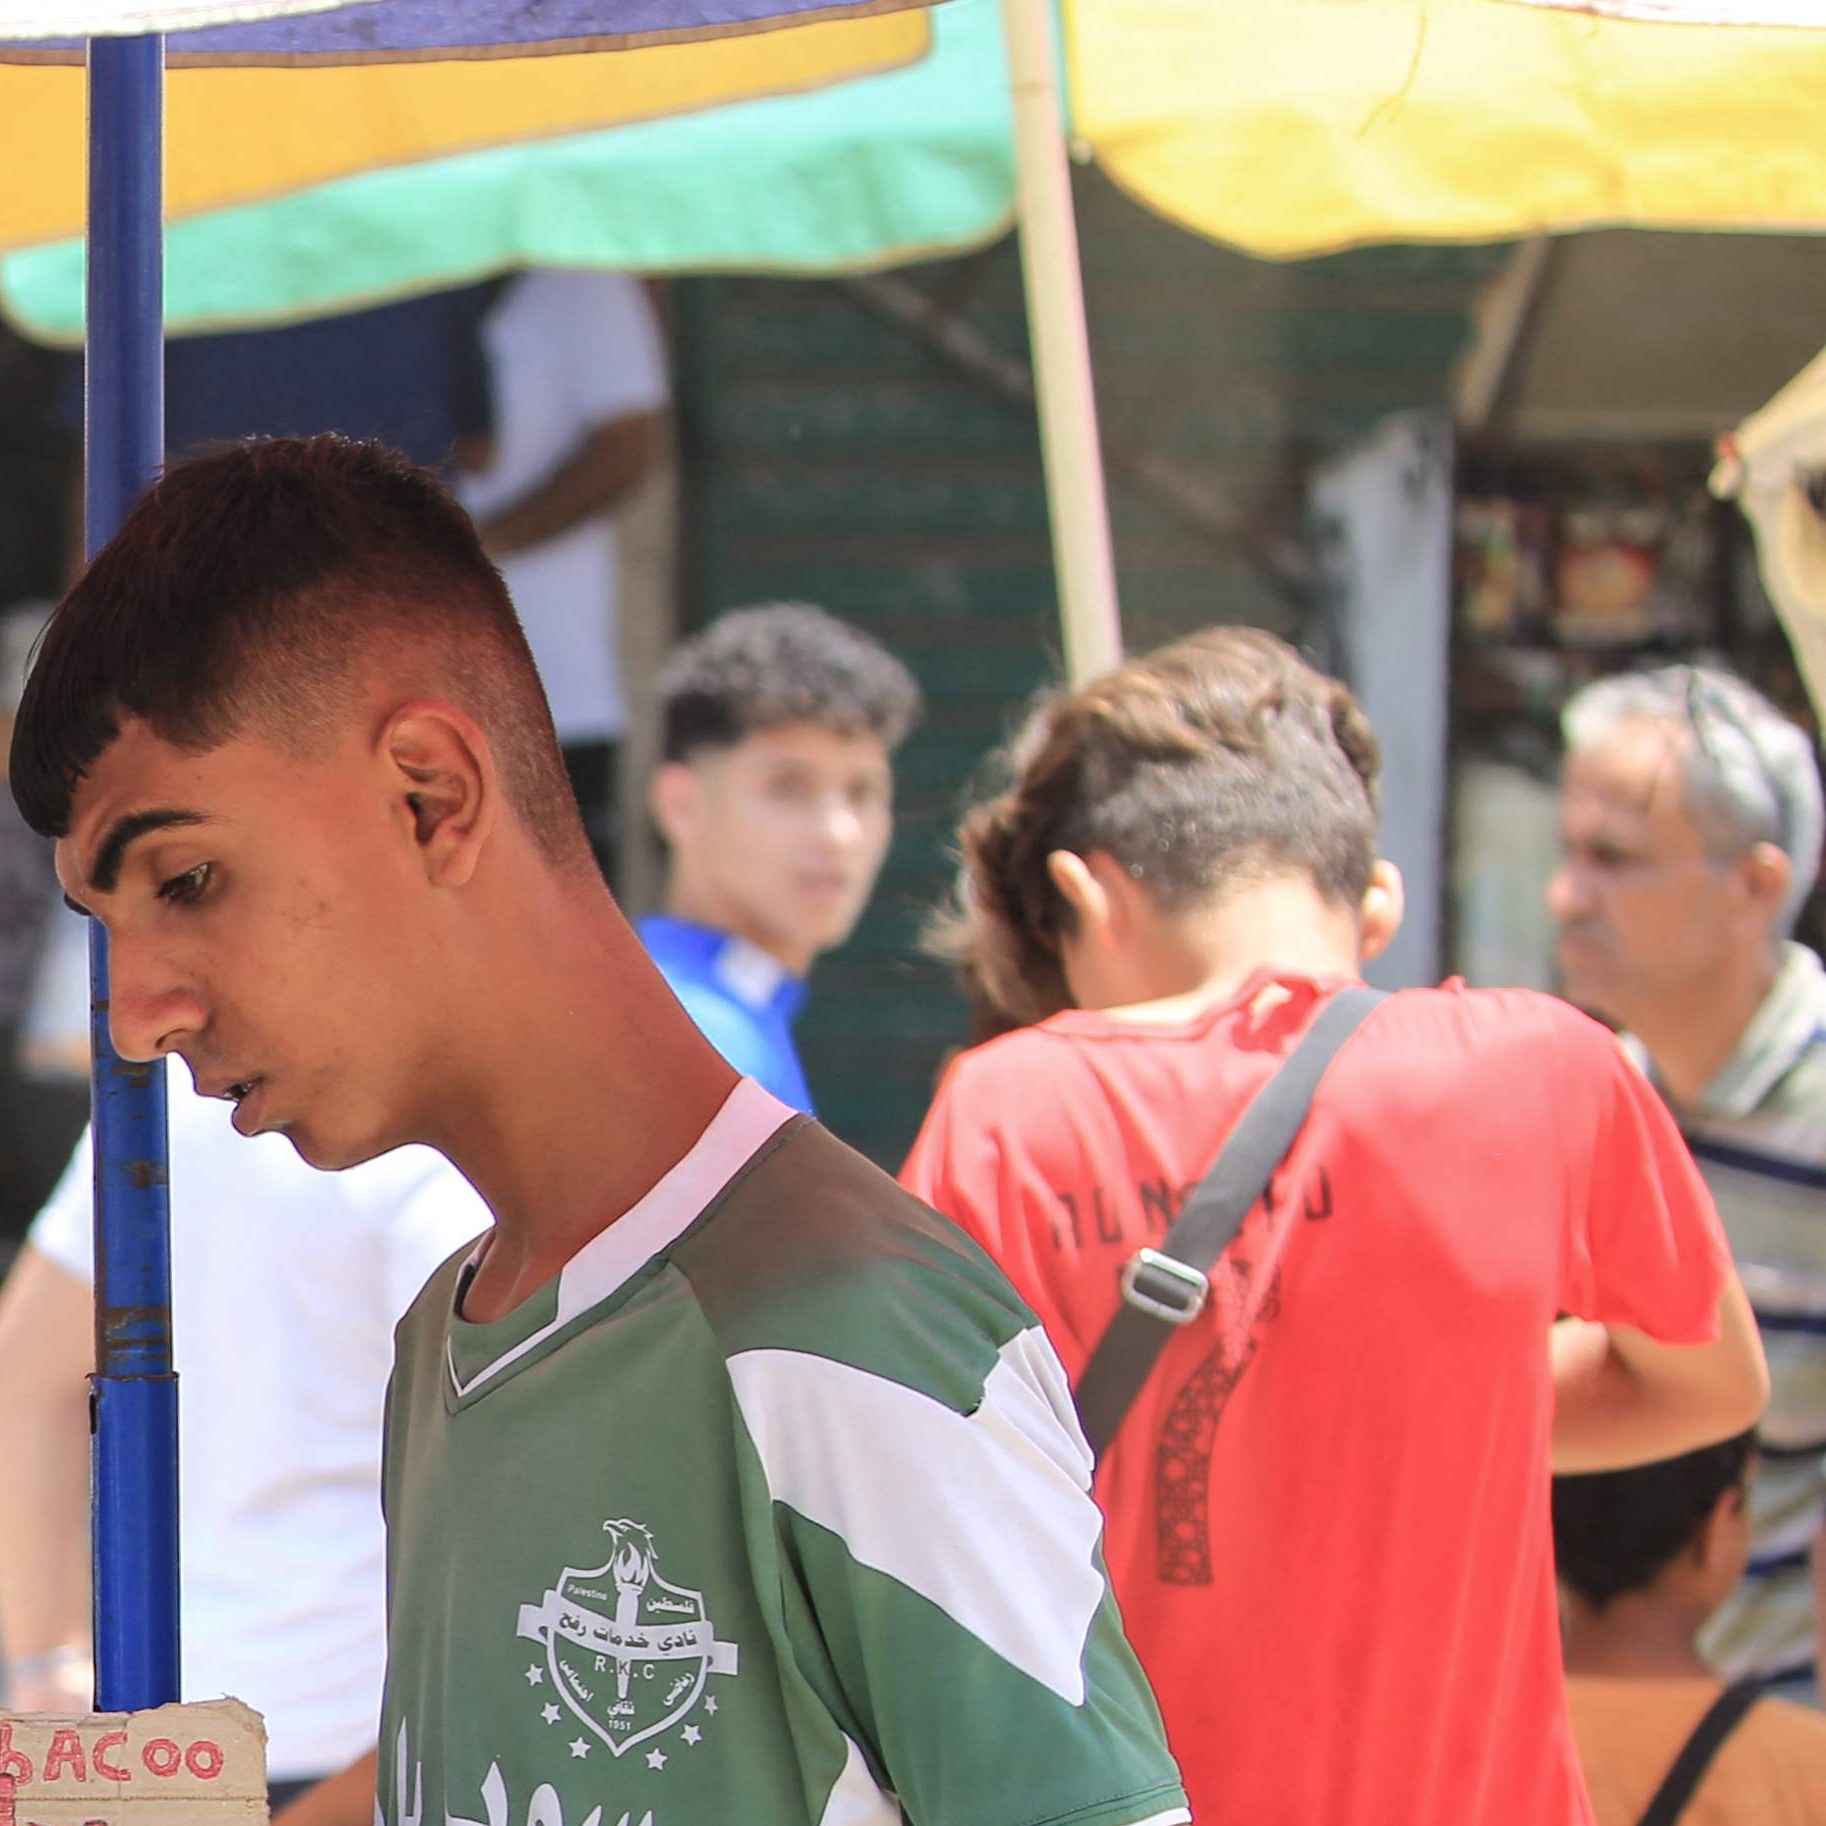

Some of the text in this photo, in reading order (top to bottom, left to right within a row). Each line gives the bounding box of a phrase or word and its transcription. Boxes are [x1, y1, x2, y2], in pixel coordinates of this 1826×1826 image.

[567, 1584, 608, 1600] Palestine
[646, 1597, 696, 1614] فلسطين
[559, 1612, 698, 1655] نادي خدمات رفح
[608, 1718, 632, 1731] 1951
